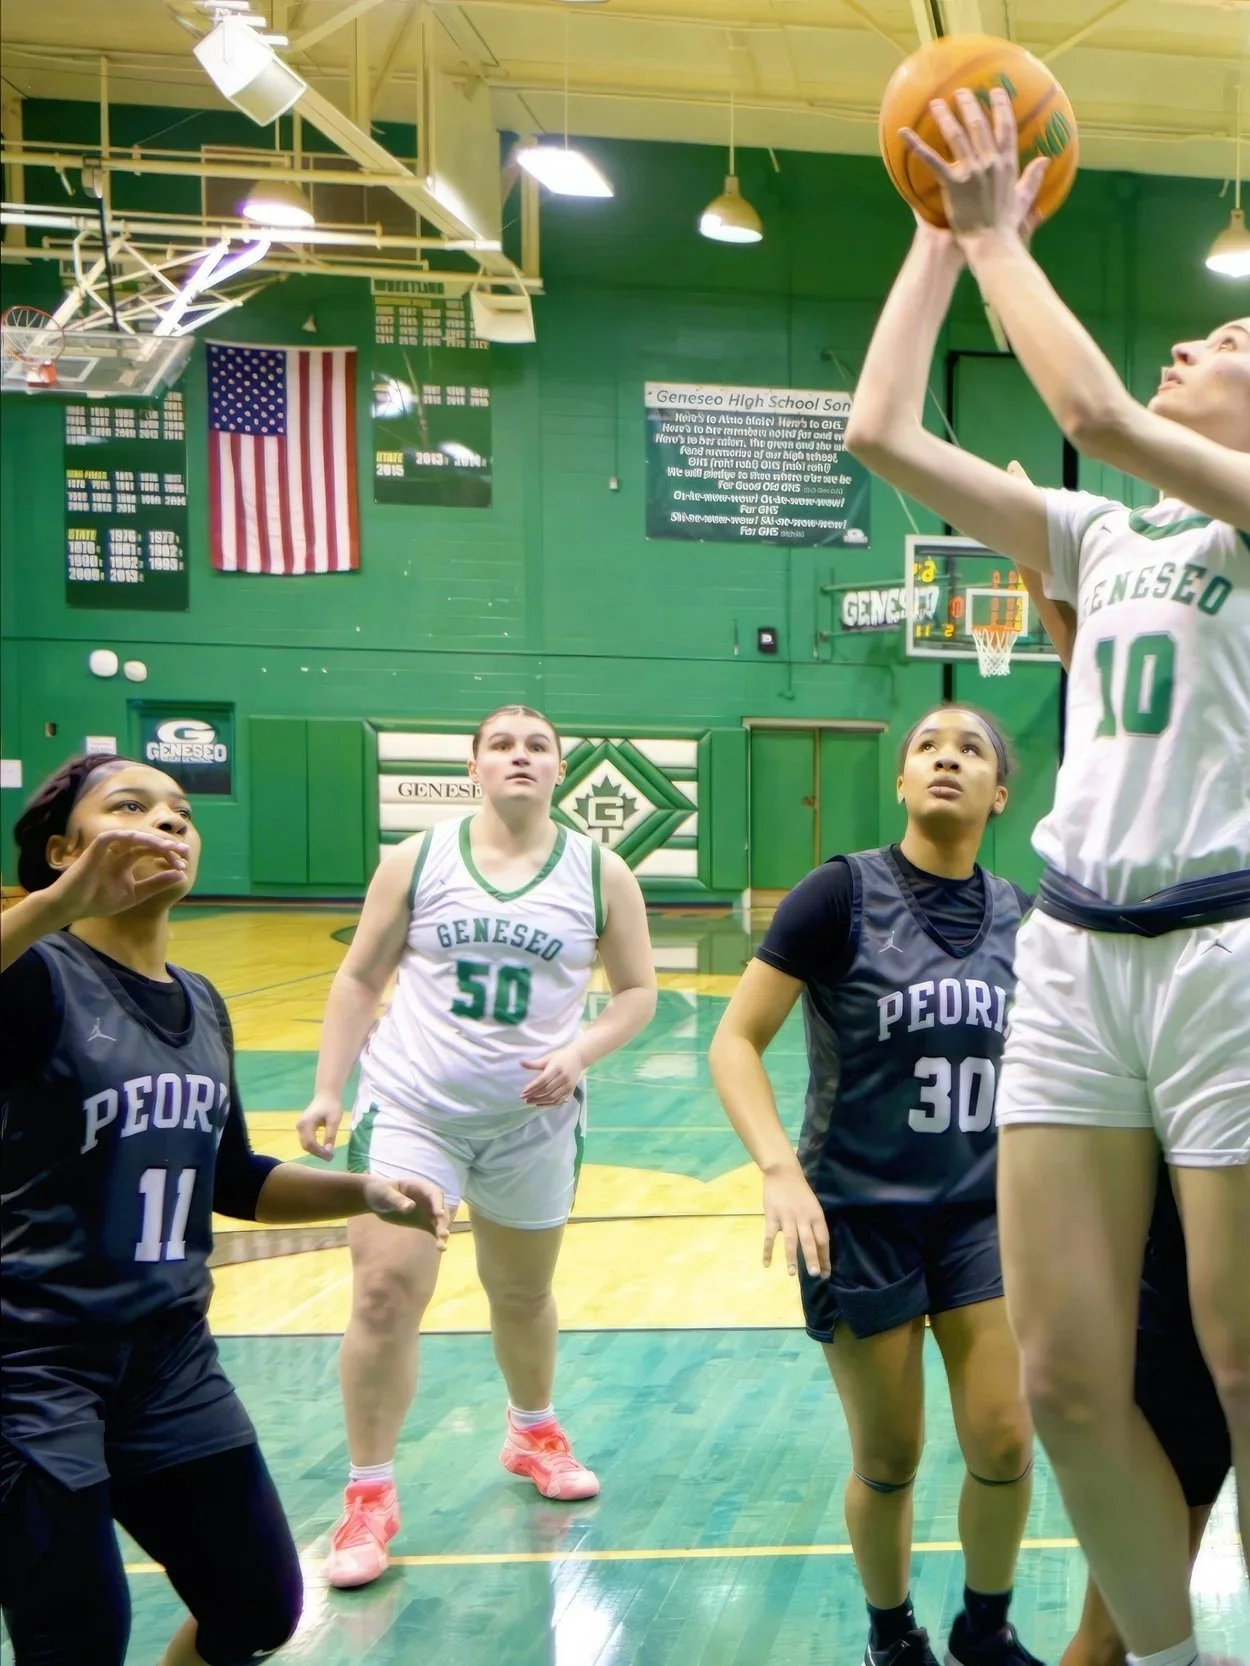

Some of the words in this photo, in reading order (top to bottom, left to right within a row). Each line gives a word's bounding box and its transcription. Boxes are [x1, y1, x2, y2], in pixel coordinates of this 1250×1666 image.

[656, 389, 723, 406] Geneseo
[728, 392, 763, 410] High
[768, 395, 819, 411] School
[823, 398, 851, 412] Son
[1085, 562, 1233, 616] ENESEO
[1093, 630, 1178, 739] 10
[146, 741, 227, 763] GENESEO
[398, 781, 483, 799] GENESE
[588, 796, 625, 827] G
[436, 917, 564, 962] GENESEO
[449, 958, 531, 1025] 50
[877, 977, 1010, 1042] PEORI
[907, 1056, 996, 1134] 30
[134, 1168, 197, 1263] 11
